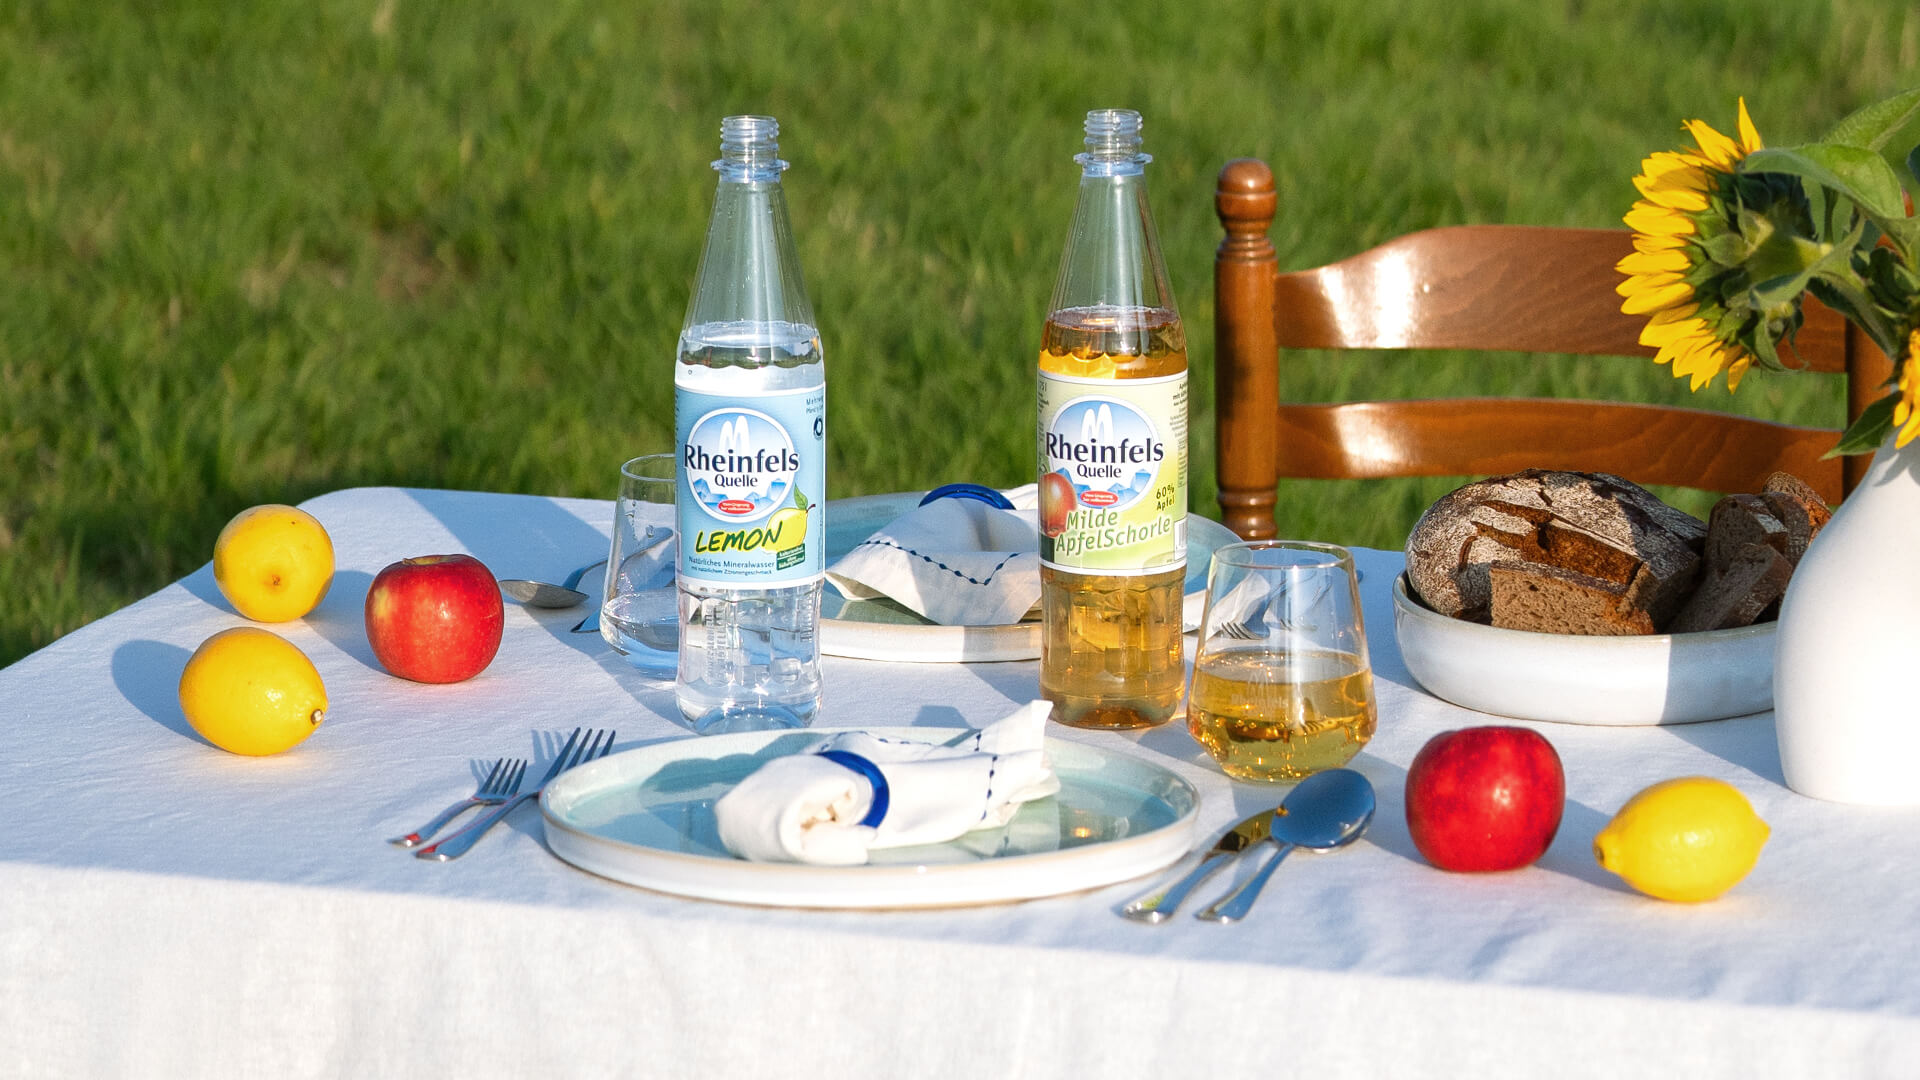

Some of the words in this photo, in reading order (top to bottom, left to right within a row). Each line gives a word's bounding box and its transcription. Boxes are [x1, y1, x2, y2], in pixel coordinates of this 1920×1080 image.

[1046, 432, 1164, 463] Rheinfels
[684, 444, 799, 473] Rheinfels
[714, 474, 758, 487] Quelle
[1077, 464, 1122, 478] Quelle
[1156, 483, 1174, 499] 60%
[1156, 495, 1174, 511] Apfel
[1066, 508, 1118, 530] Milde
[695, 521, 783, 553] LEMON
[1056, 516, 1171, 556] ApfelSchorle
[688, 556, 721, 567] Natürliches
[723, 560, 775, 568] Mineralwasser
